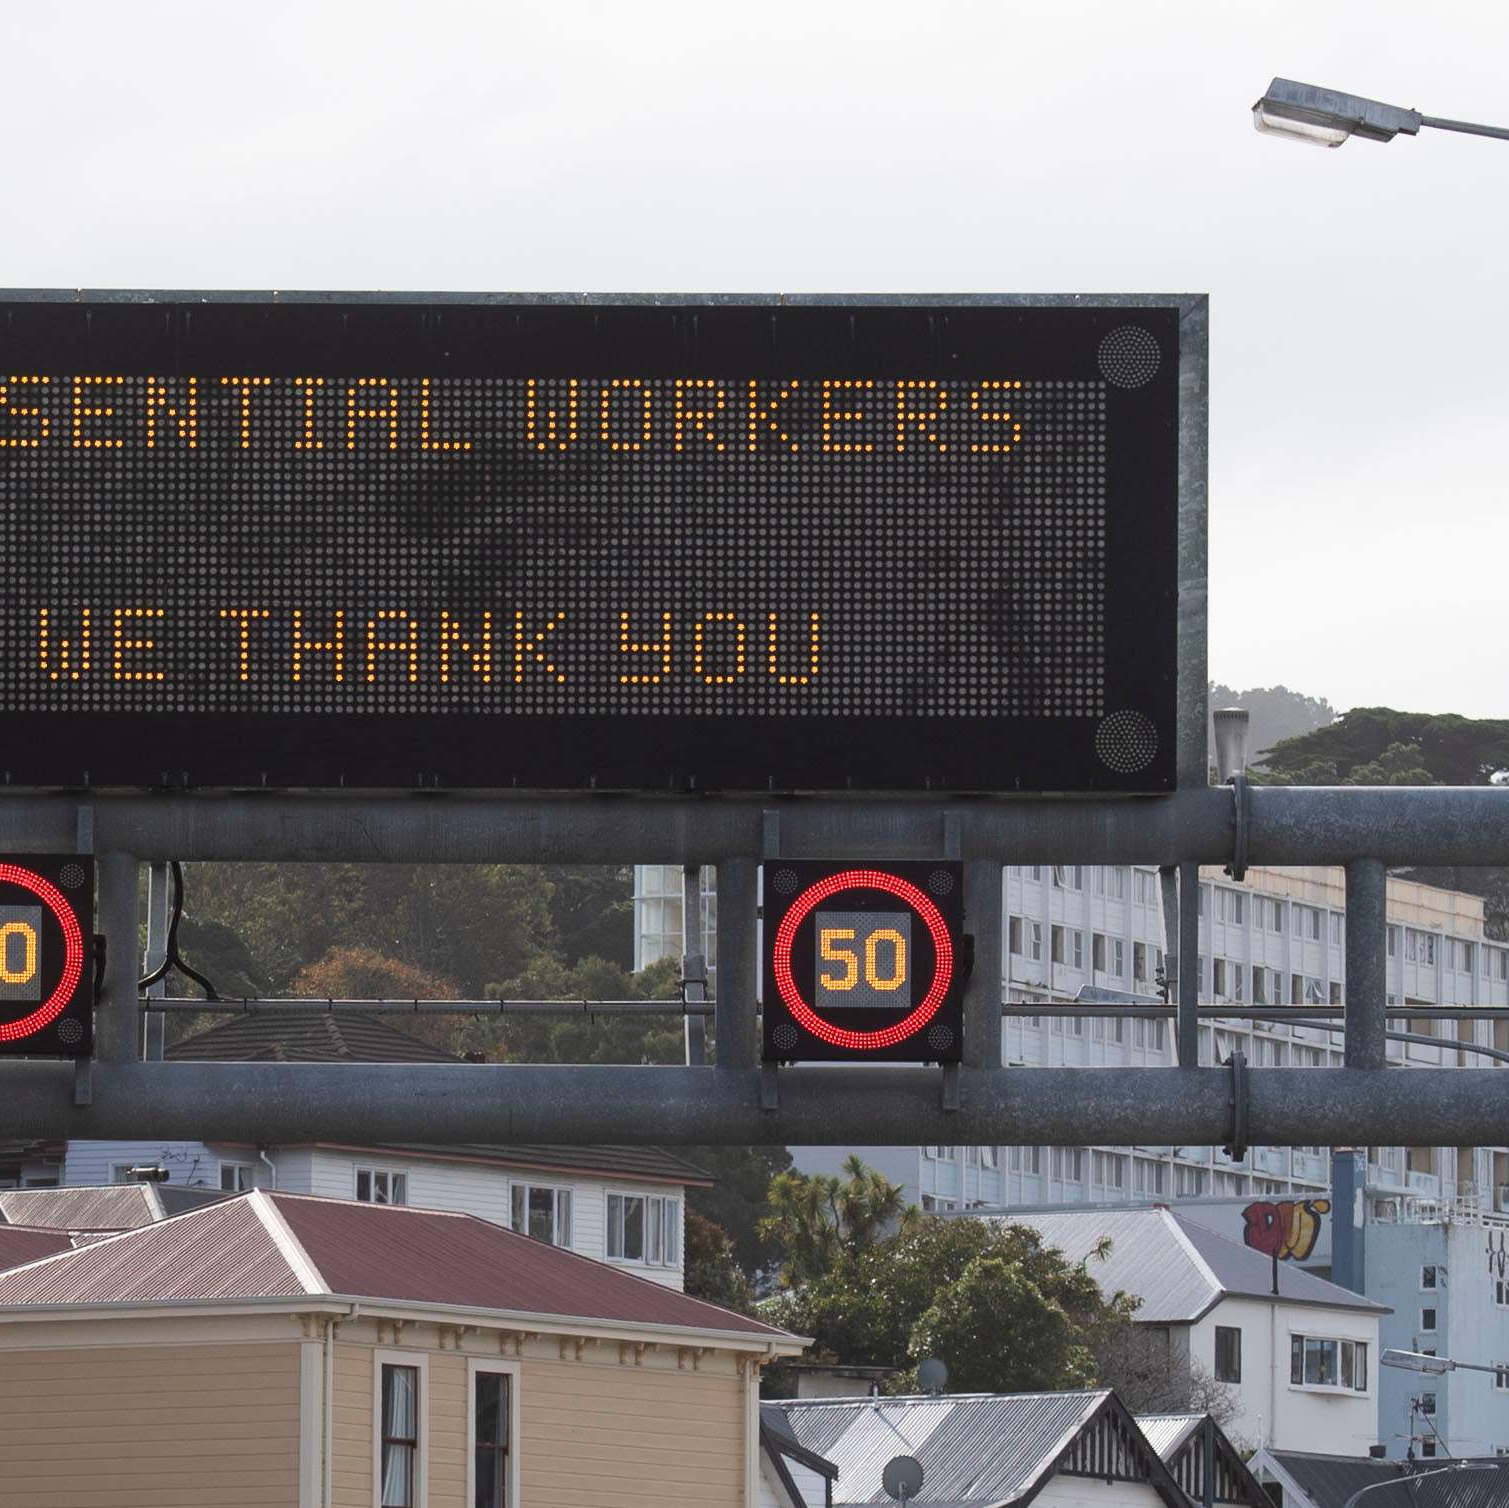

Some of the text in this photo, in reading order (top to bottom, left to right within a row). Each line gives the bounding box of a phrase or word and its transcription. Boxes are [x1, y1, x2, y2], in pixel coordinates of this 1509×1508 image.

[526, 379, 1024, 454] WORKERS
[39, 608, 822, 686] WE THANK YOU
[820, 929, 906, 991] 50
